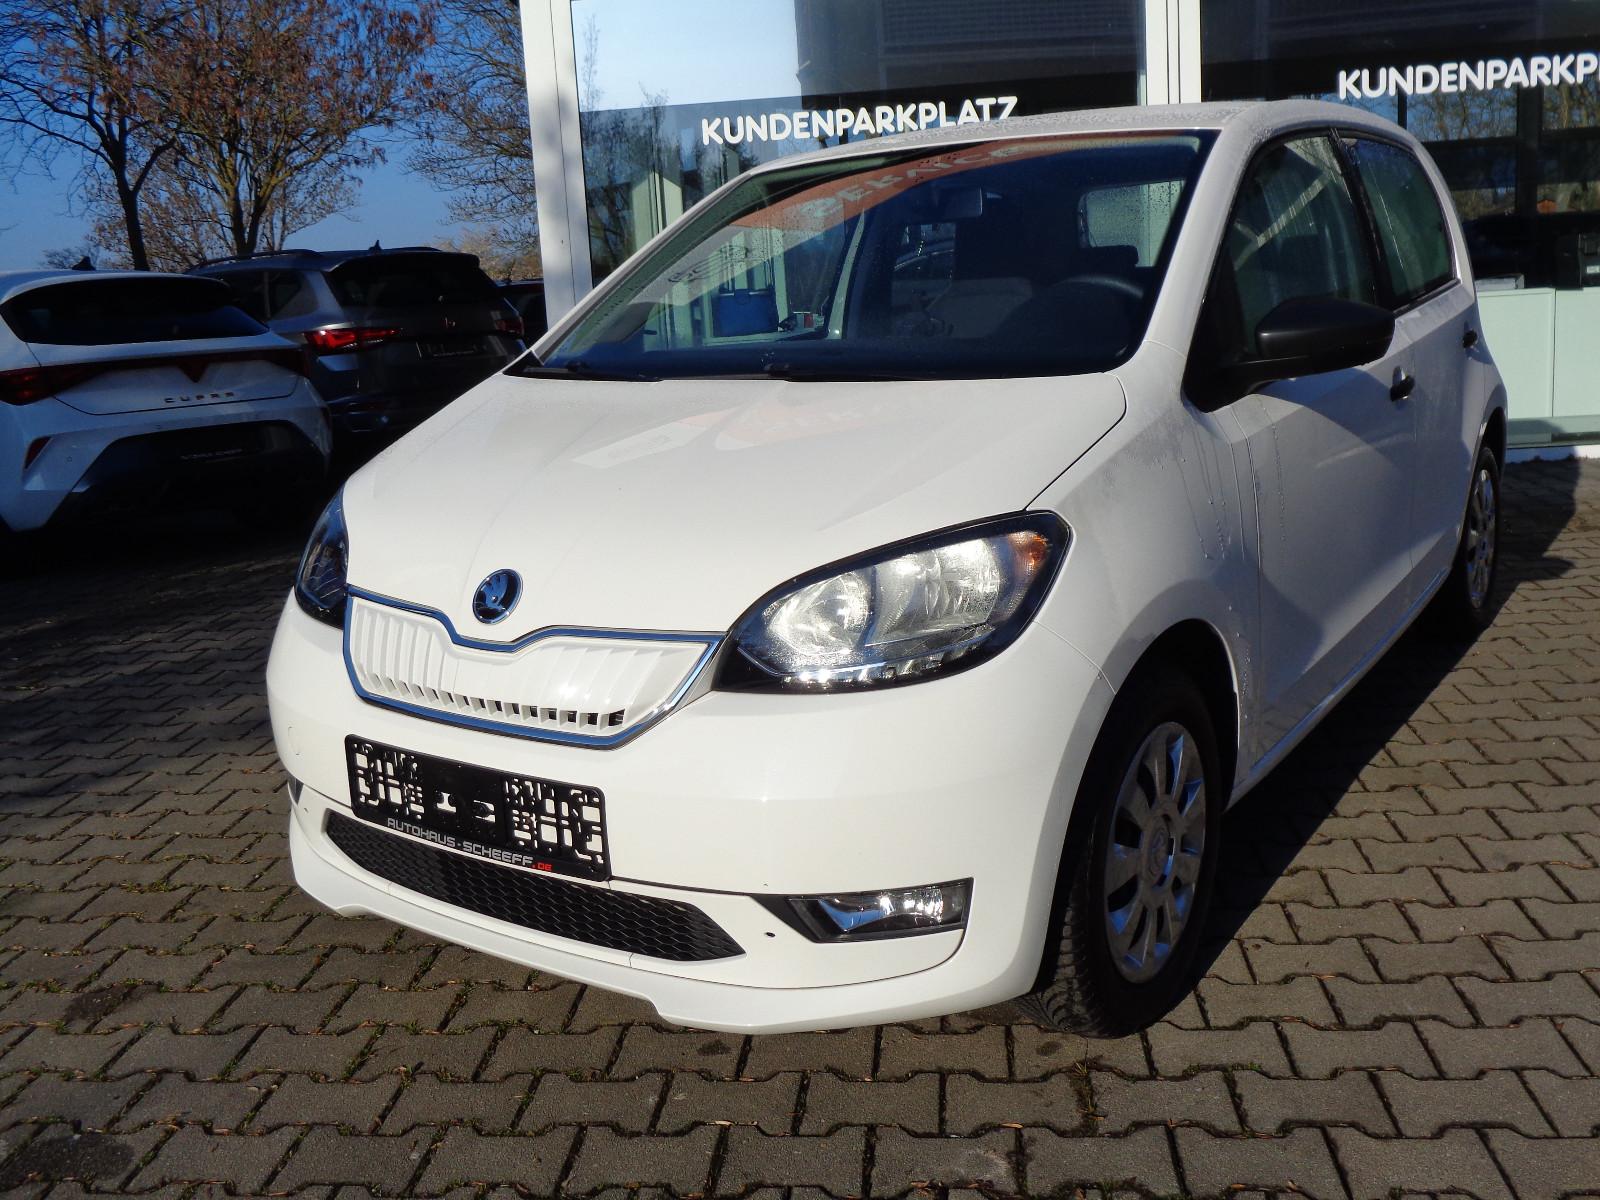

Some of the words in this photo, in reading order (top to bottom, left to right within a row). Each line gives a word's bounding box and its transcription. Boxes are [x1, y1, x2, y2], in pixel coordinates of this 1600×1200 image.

[1339, 53, 1600, 99] KUNDENPARKP
[701, 96, 1018, 145] KUNDENPARKPLATZ
[164, 391, 235, 404] CUPRA
